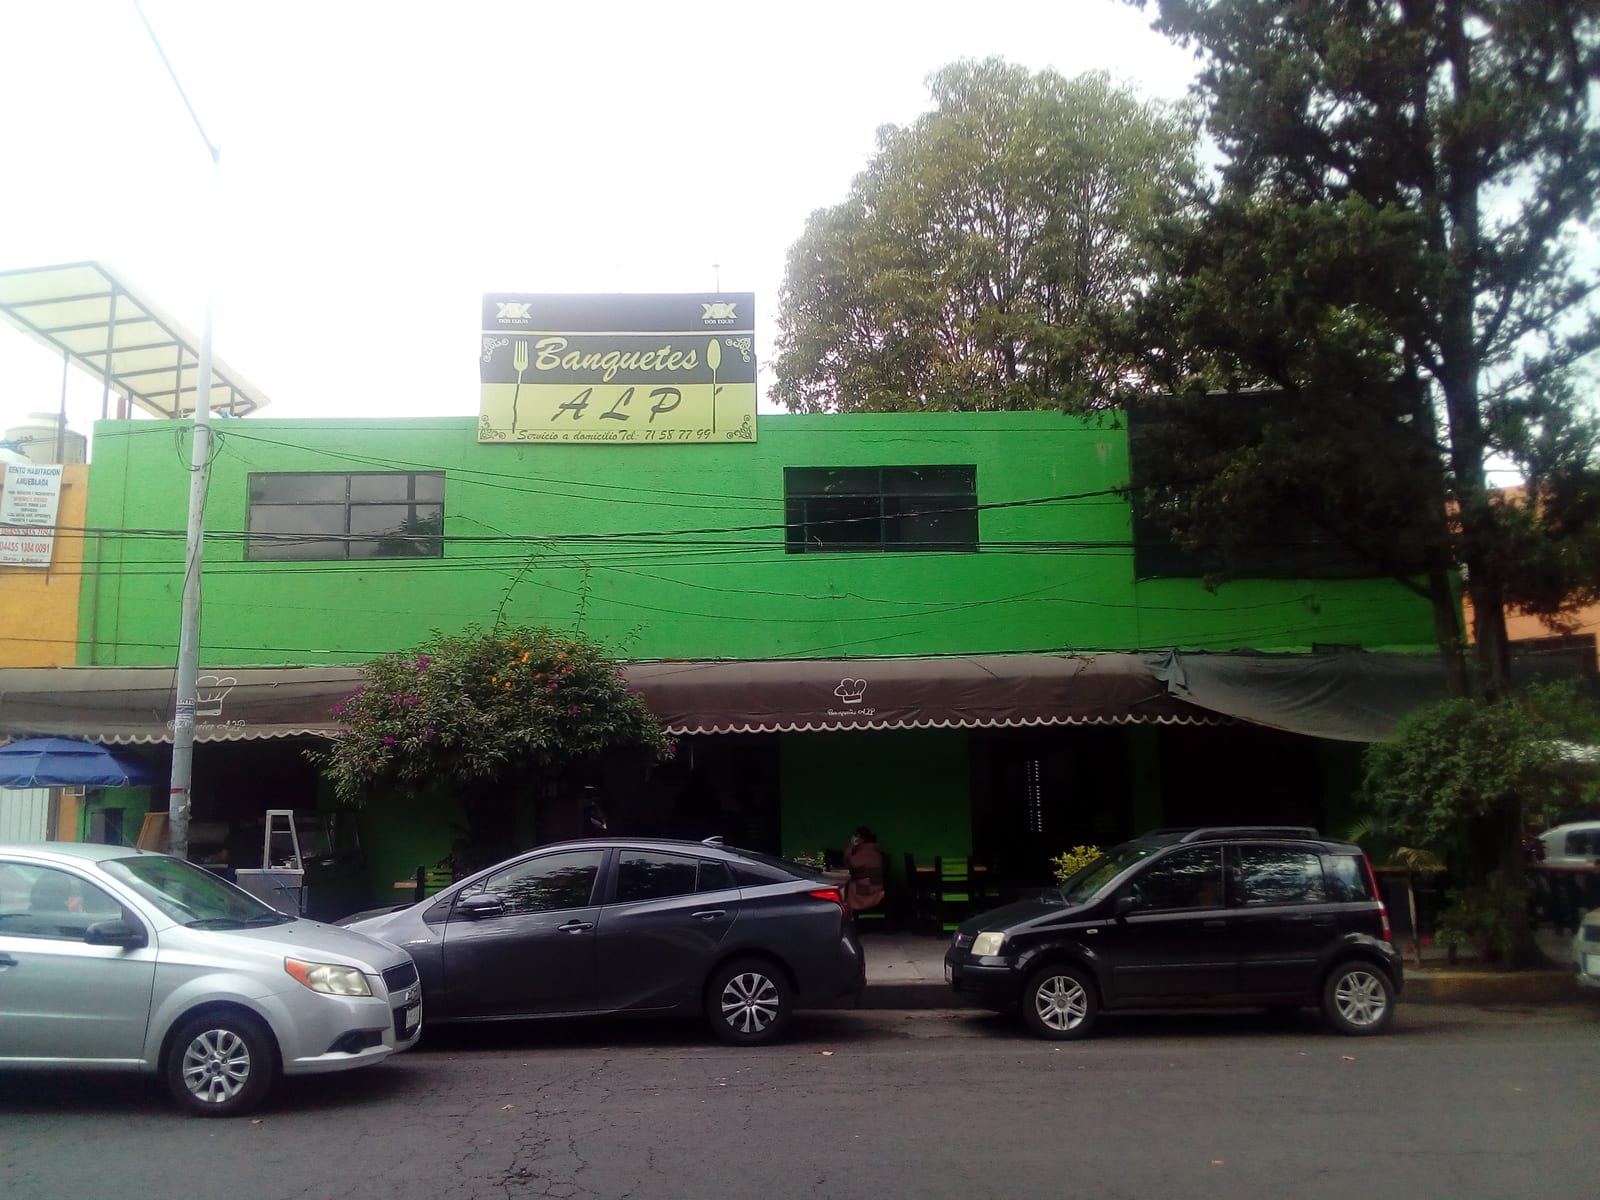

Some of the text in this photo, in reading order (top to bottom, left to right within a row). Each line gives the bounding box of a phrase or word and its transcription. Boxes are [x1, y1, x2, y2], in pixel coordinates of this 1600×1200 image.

[535, 337, 698, 382] Banquetes
[517, 429, 558, 440] Servicio
[573, 431, 618, 441] domicilio
[645, 429, 656, 440] 71
[659, 429, 675, 440] 58
[678, 429, 693, 440] 77
[696, 428, 711, 440] 99
